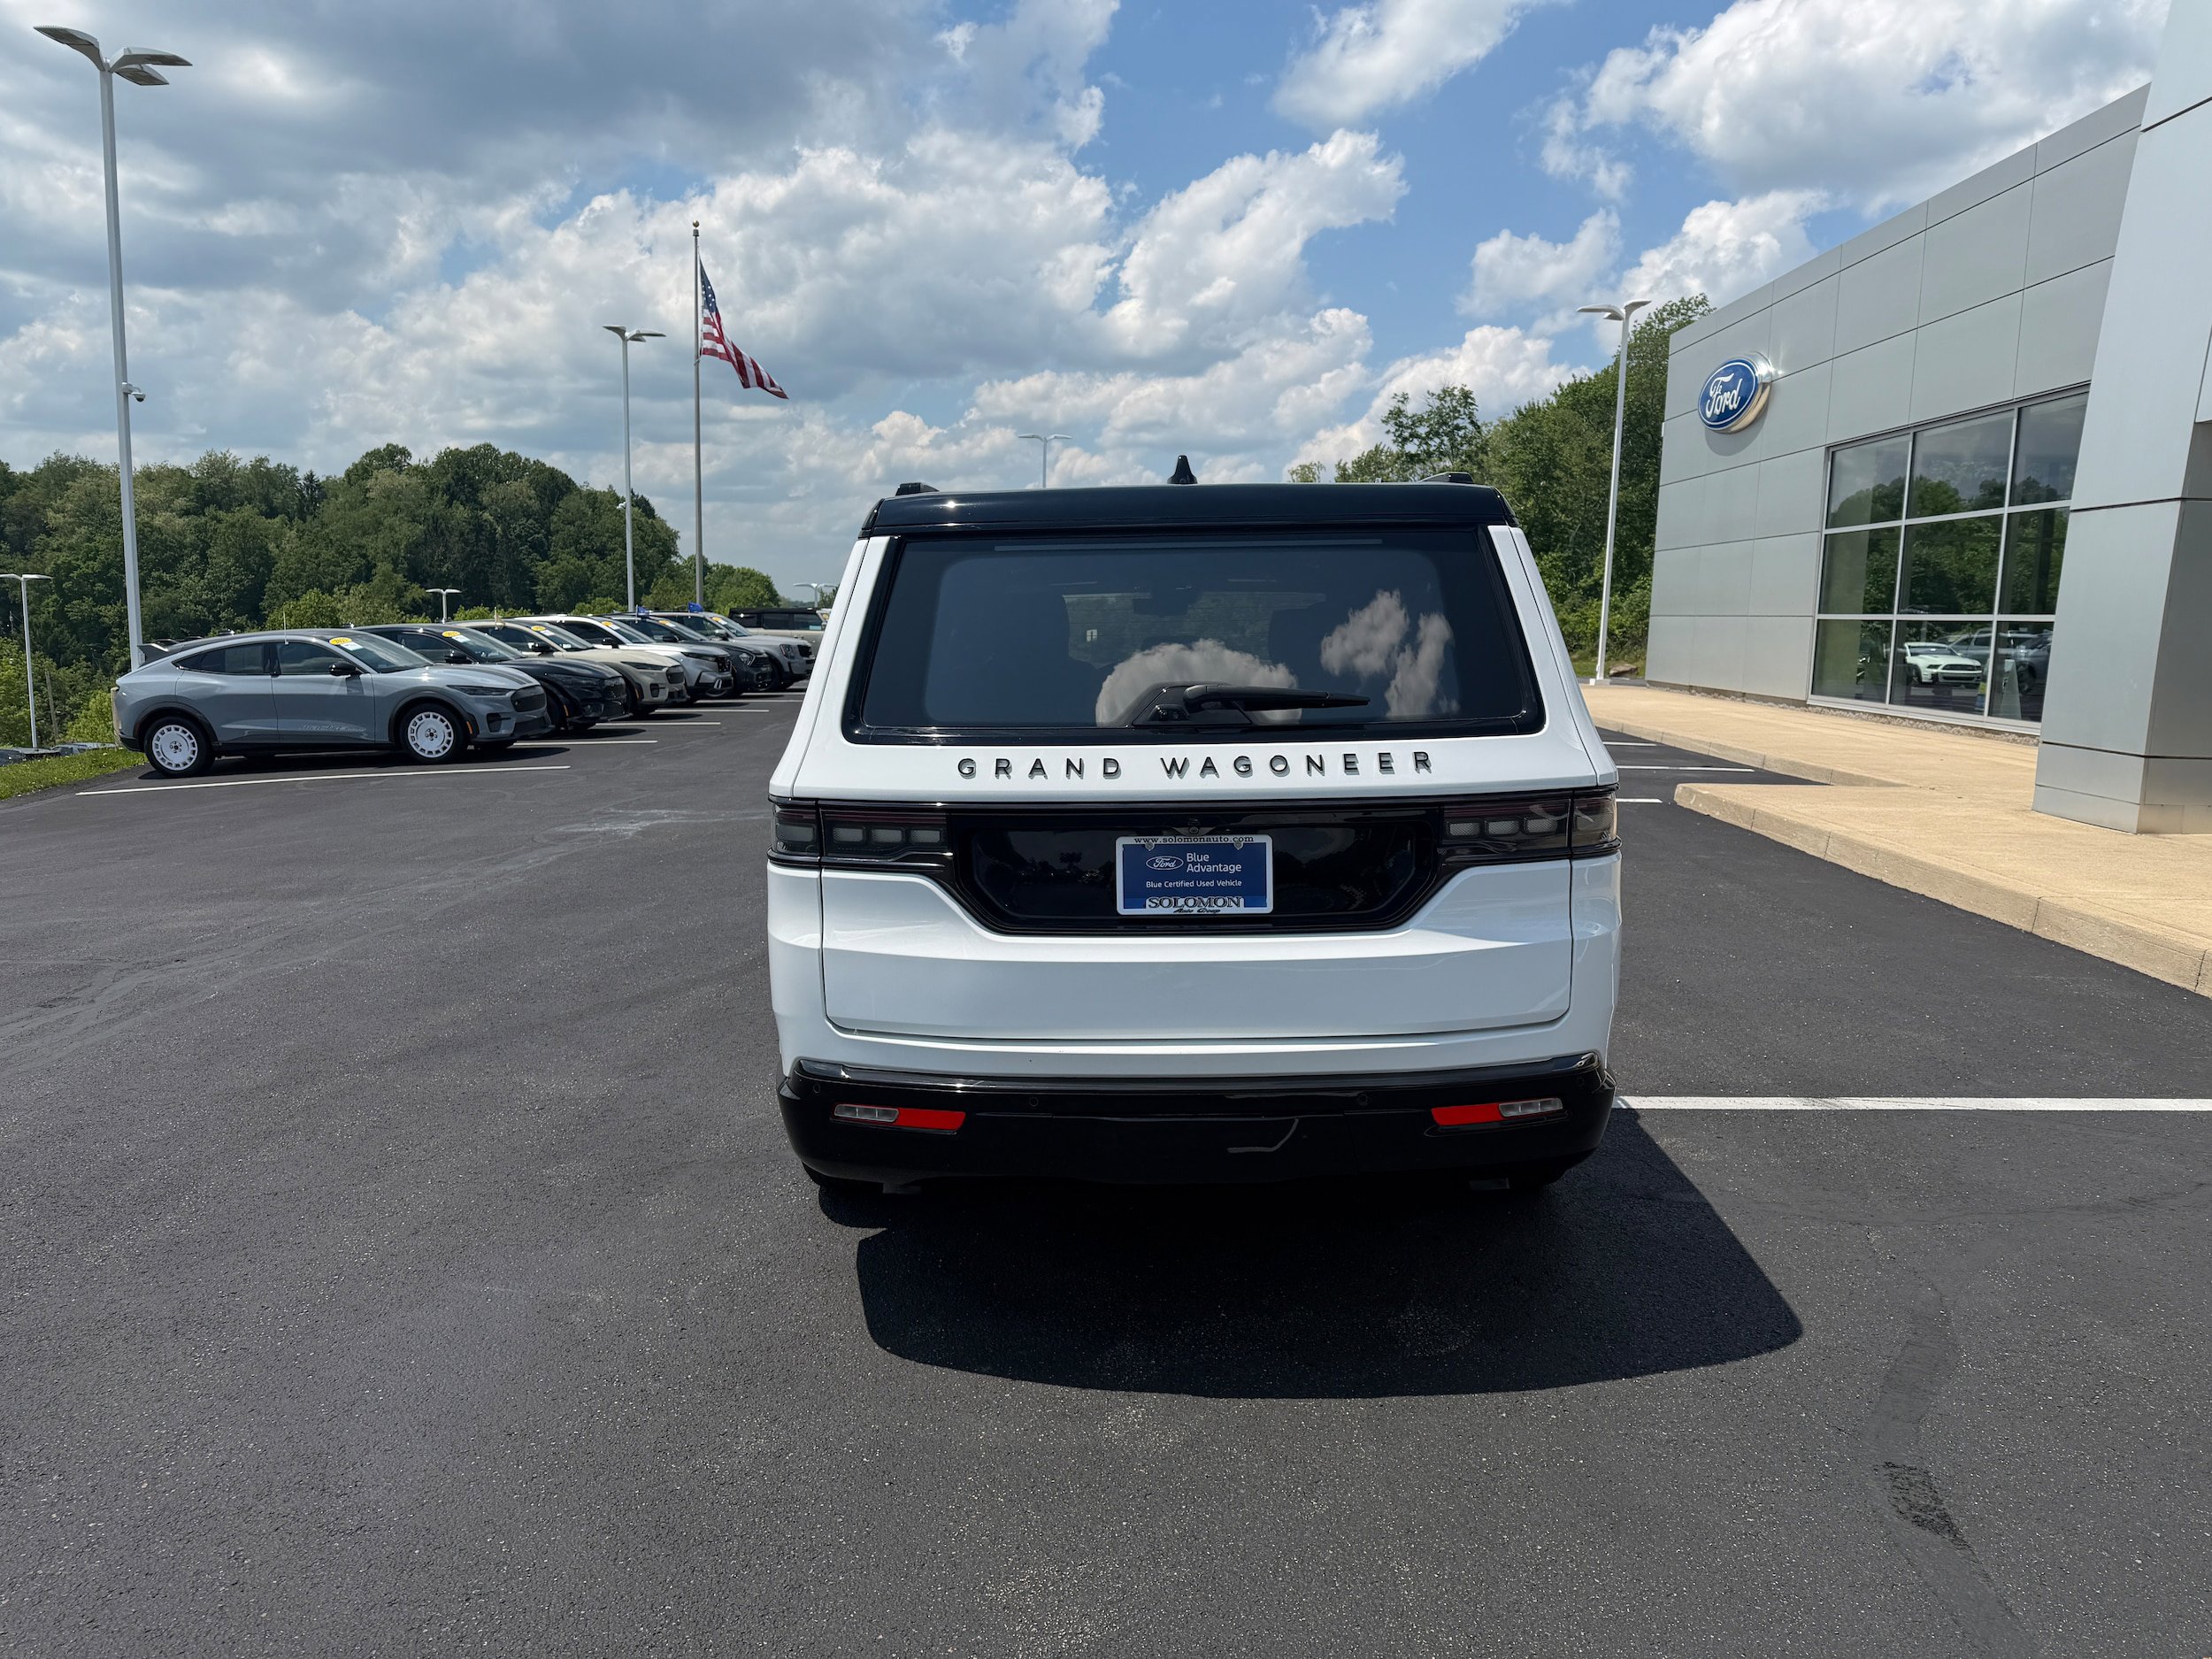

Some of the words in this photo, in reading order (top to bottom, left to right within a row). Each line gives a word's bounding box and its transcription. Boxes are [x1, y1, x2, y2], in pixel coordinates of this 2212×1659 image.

[1705, 373, 1742, 419] Ford
[957, 757, 1121, 779] GRAND
[1160, 751, 1431, 779] WAGONEER
[1153, 857, 1176, 868] Ford
[1187, 852, 1210, 862] Blue
[1186, 863, 1241, 873] Advantage
[1148, 896, 1242, 909] SOLOMON
